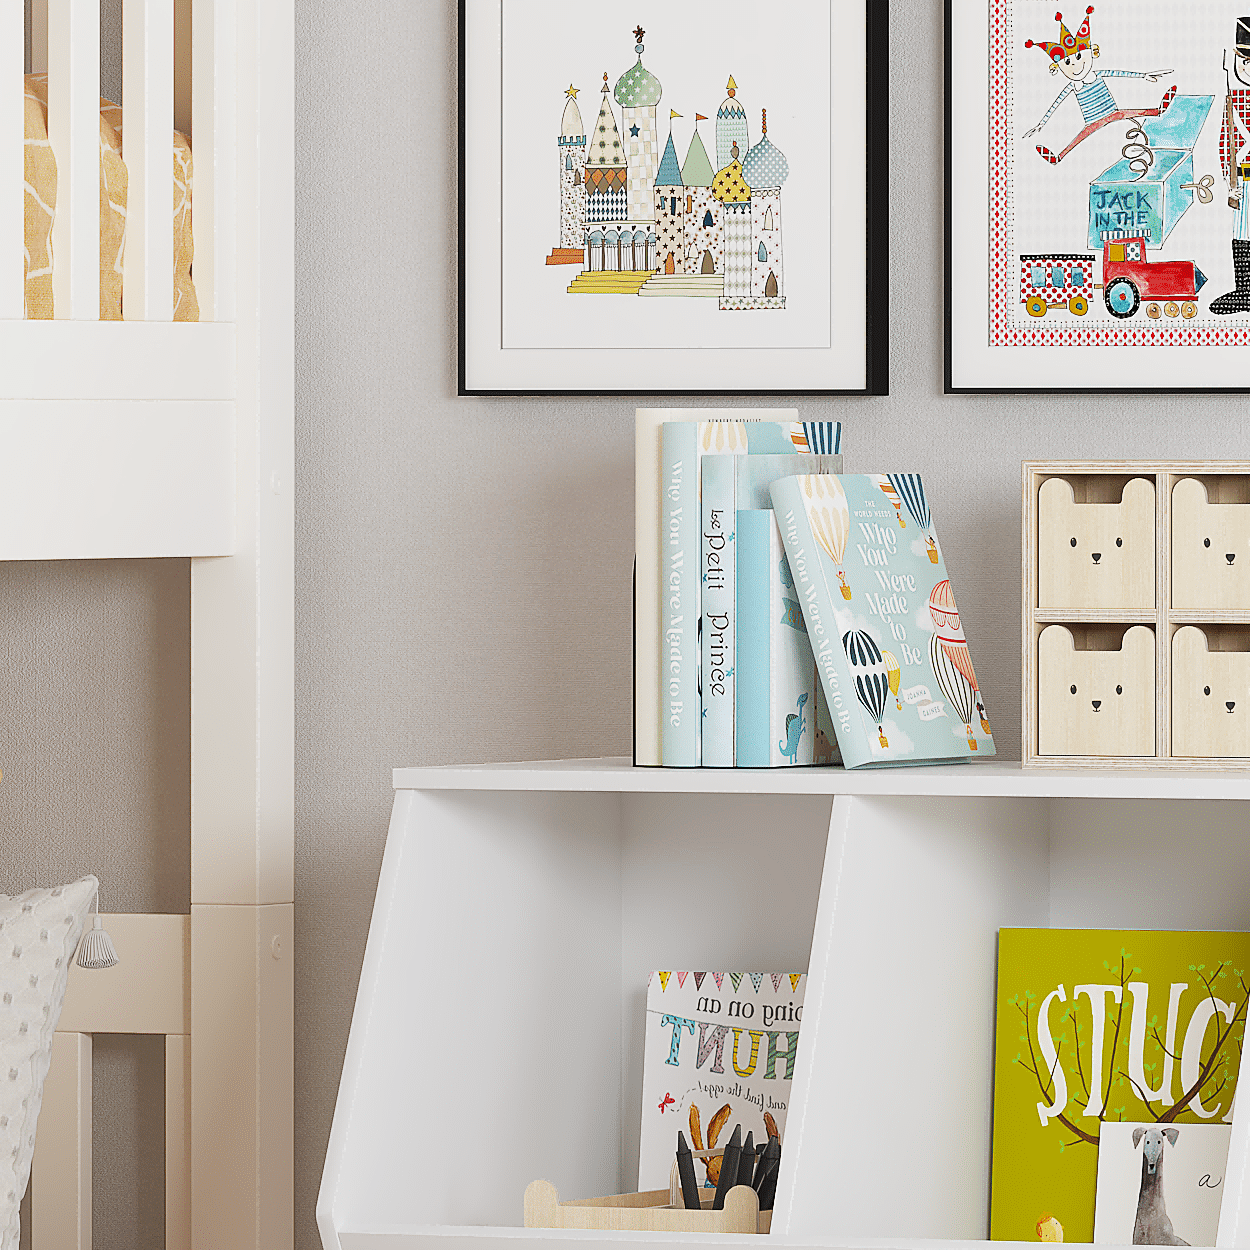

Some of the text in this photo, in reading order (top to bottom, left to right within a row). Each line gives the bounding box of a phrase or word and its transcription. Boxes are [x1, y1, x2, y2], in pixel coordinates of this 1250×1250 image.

[1093, 190, 1152, 211] JACK
[1095, 211, 1149, 228] IN THE
[853, 510, 892, 518] WORLD NEEDS
[864, 500, 876, 508] THE
[669, 506, 683, 545] You
[858, 522, 897, 555] Who
[856, 543, 889, 566] You
[669, 550, 684, 610] Were
[874, 570, 917, 593] Were
[704, 509, 729, 697] Le Petit Prince
[865, 592, 909, 624] Made
[794, 548, 809, 583] You
[805, 583, 824, 636] Were
[818, 637, 839, 690] Made
[831, 690, 843, 709] to
[838, 709, 851, 734] Be
[889, 619, 907, 641] to
[666, 613, 684, 674] Made
[900, 643, 923, 666] Be
[669, 677, 682, 697] to
[907, 690, 927, 700] JOANNA
[670, 701, 684, 727] Be
[922, 706, 941, 717] GAINES
[1036, 981, 1236, 1127] STUC
